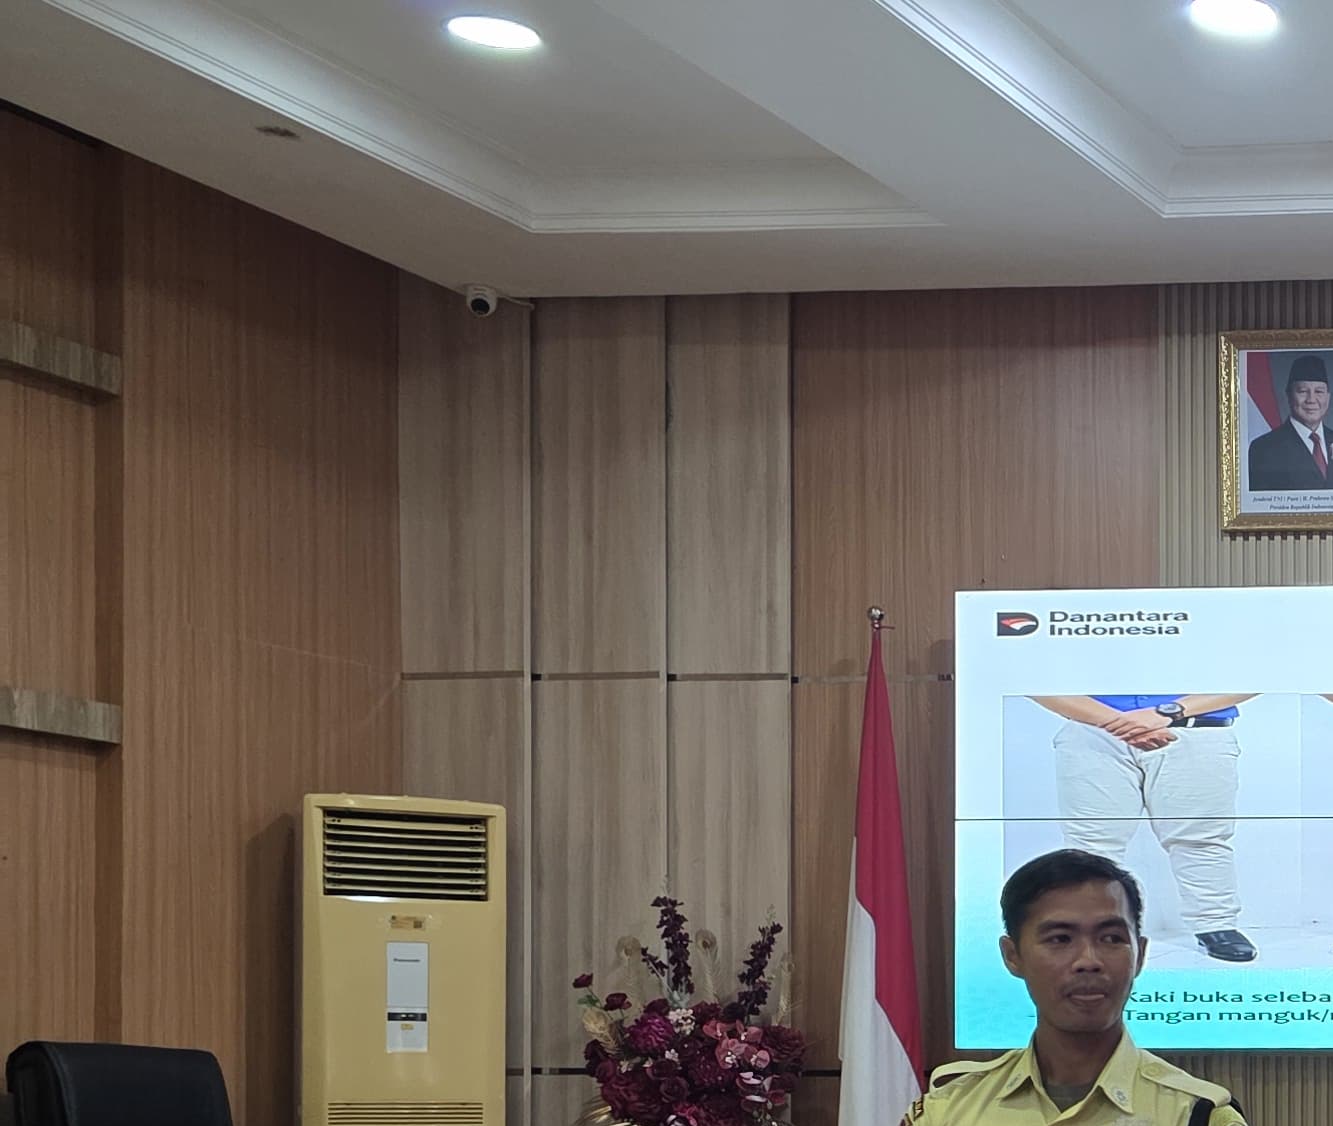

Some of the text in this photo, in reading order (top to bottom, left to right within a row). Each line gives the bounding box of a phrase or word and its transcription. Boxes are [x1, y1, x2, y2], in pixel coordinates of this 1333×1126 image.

[1049, 610, 1190, 623] Danantara
[1049, 623, 1181, 636] Indonesia
[1183, 991, 1244, 1003] buka
[1124, 1009, 1211, 1024] Tangan
